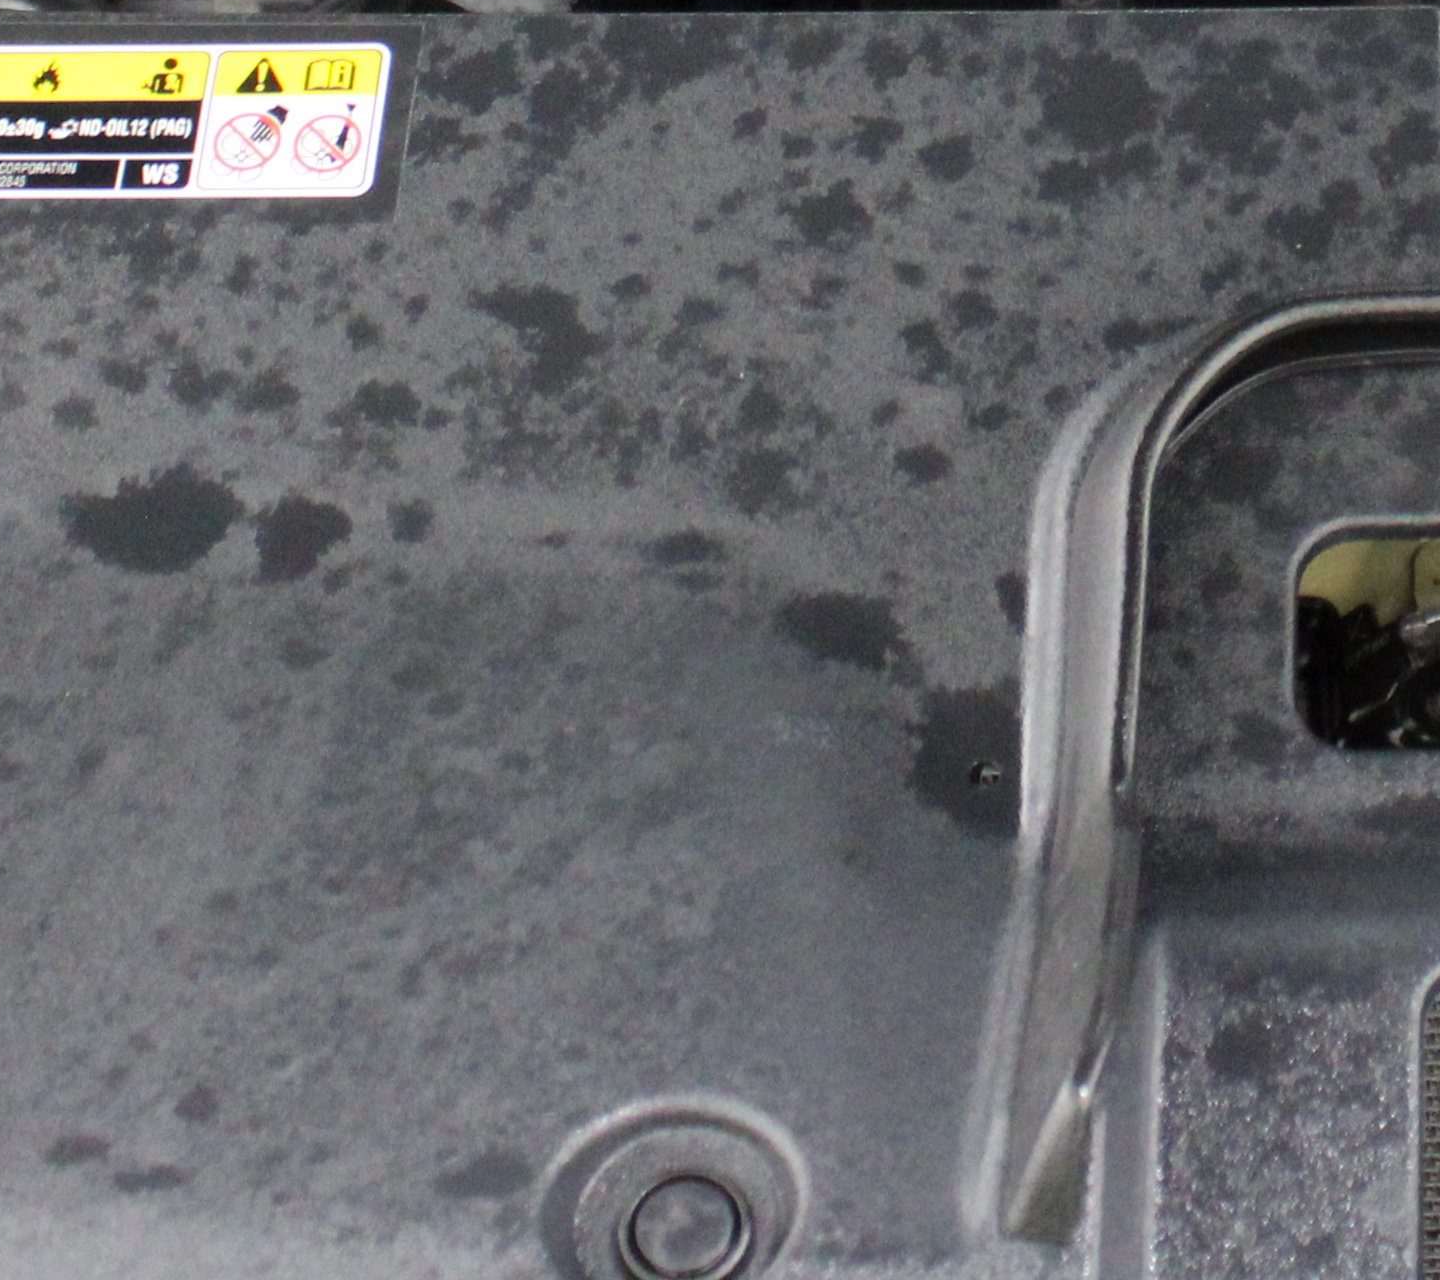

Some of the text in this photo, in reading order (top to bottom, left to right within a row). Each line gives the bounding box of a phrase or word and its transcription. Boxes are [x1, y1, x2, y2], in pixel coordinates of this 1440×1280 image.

[78, 118, 149, 138] ND-OIL12
[150, 118, 193, 139] (PAG)
[141, 163, 180, 186] WS
